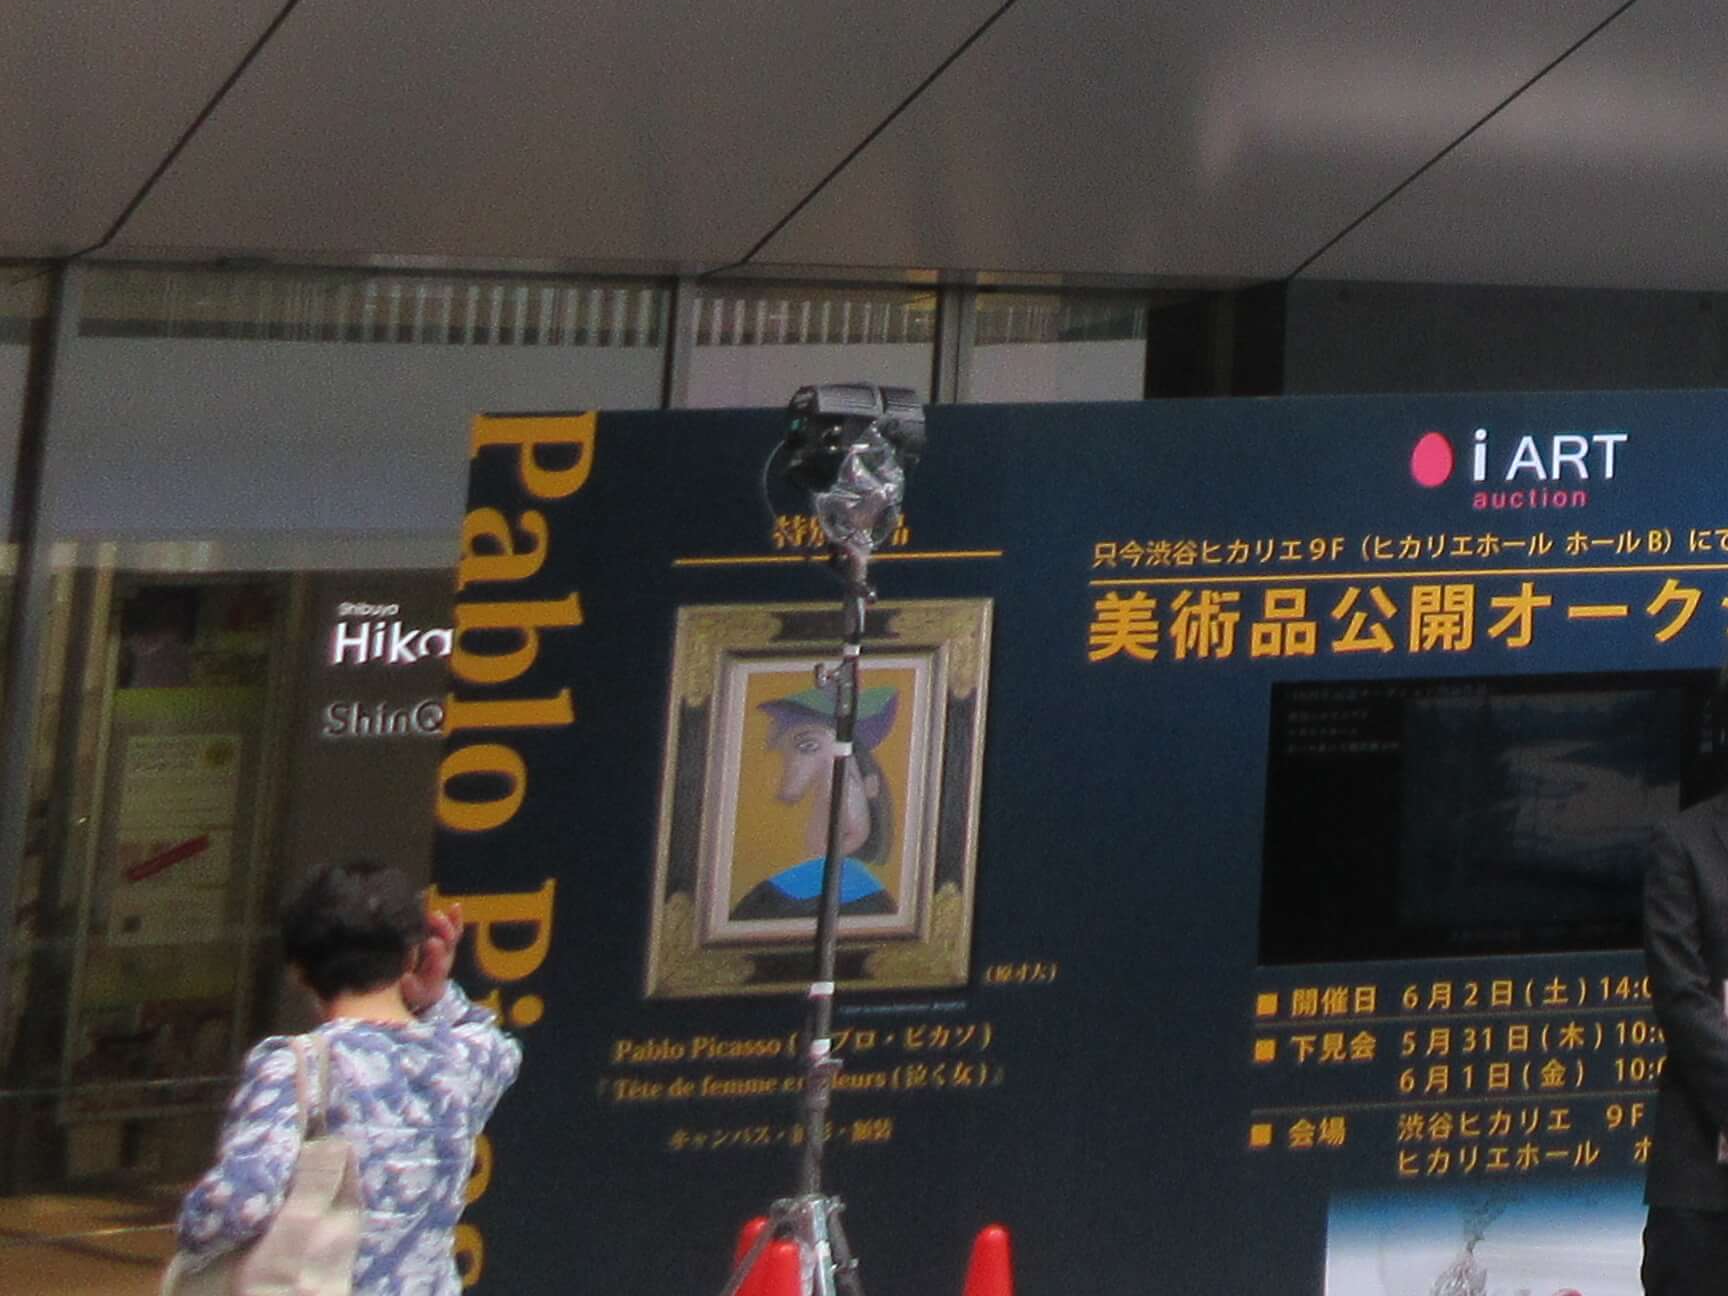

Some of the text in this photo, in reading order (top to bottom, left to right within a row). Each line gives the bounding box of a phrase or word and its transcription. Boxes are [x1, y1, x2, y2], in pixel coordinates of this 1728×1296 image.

[1505, 434, 1628, 481] ART
[1472, 488, 1589, 509] auction
[434, 410, 598, 832] Pablo
[1290, 986, 1377, 1018] 開催日
[614, 1038, 685, 1063] Pablo
[692, 1034, 782, 1059] Picasso
[1290, 1030, 1377, 1064] 下見会
[1287, 1116, 1346, 1148] 会場
[1397, 1107, 1572, 1141] 渋谷ヒカリエ
[1398, 1138, 1600, 1176] ヒカリエホール
